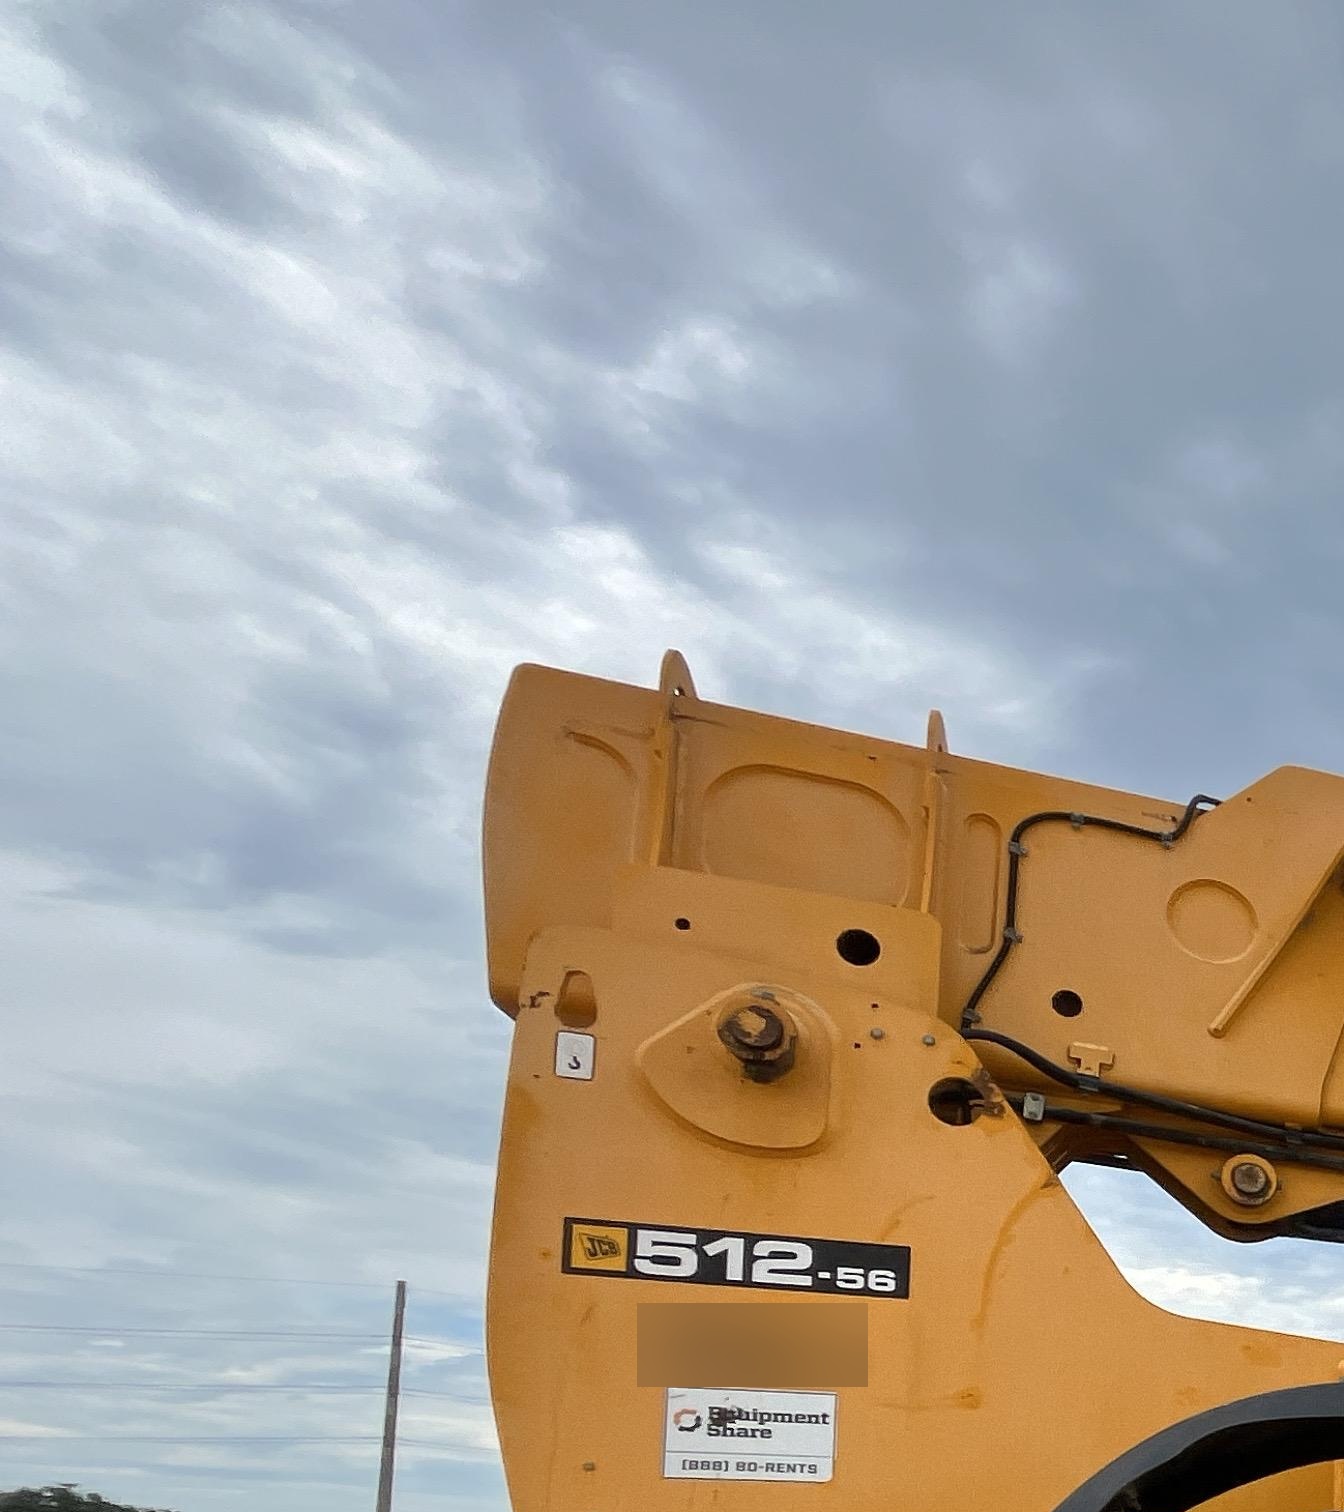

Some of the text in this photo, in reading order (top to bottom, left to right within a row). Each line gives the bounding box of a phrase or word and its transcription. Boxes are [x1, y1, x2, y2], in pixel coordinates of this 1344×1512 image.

[633, 1228, 897, 1293] 512-56
[707, 1406, 830, 1425] Euipment
[707, 1424, 772, 1439] Share
